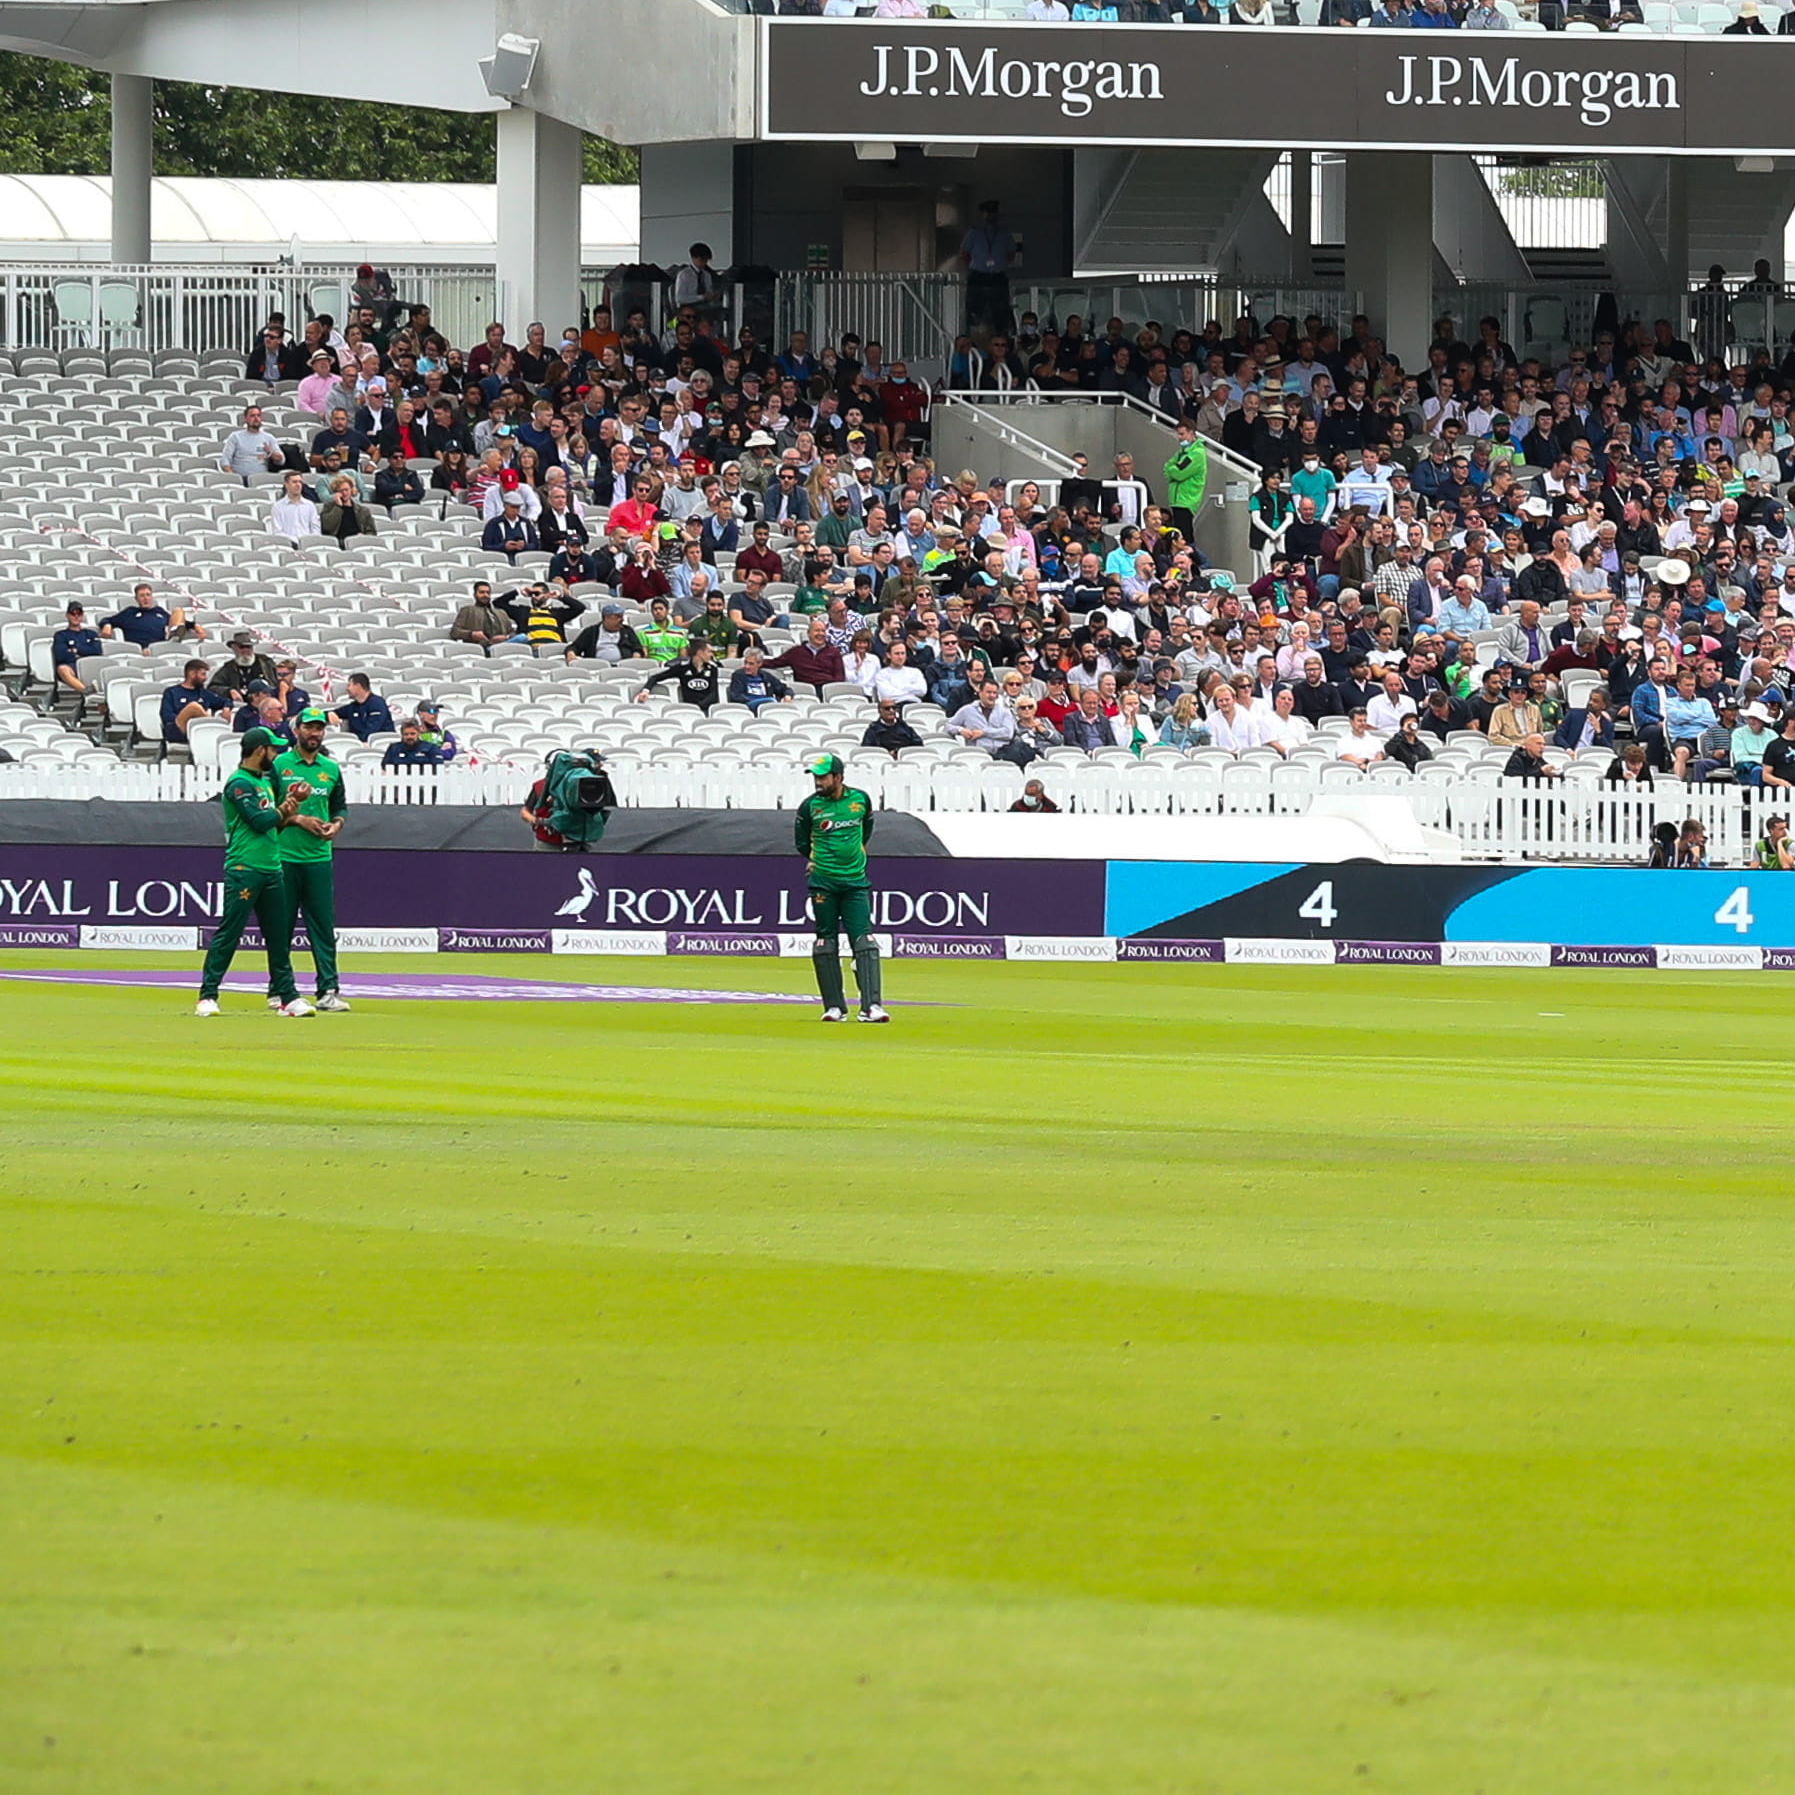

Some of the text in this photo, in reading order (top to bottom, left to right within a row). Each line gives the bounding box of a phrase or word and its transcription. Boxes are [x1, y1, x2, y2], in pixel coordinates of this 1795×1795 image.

[861, 46, 1163, 116] J.P.Morgan
[1387, 56, 1680, 125] J.P.Morgan
[0, 880, 224, 916] YAL LON
[1299, 882, 1337, 926] 4
[607, 889, 989, 927] ROYAL LDON
[1715, 887, 1753, 932] 4
[19, 933, 68, 943] LONDON
[459, 937, 545, 948] ROYAL LONDON
[687, 940, 772, 950] ROYAL LONDON
[906, 943, 991, 954] ROYAL LONDON
[1128, 946, 1211, 957] ROYAL LONDON
[1350, 948, 1432, 960] ROYAL LONDON
[1568, 952, 1648, 963] ROYAL LONDON
